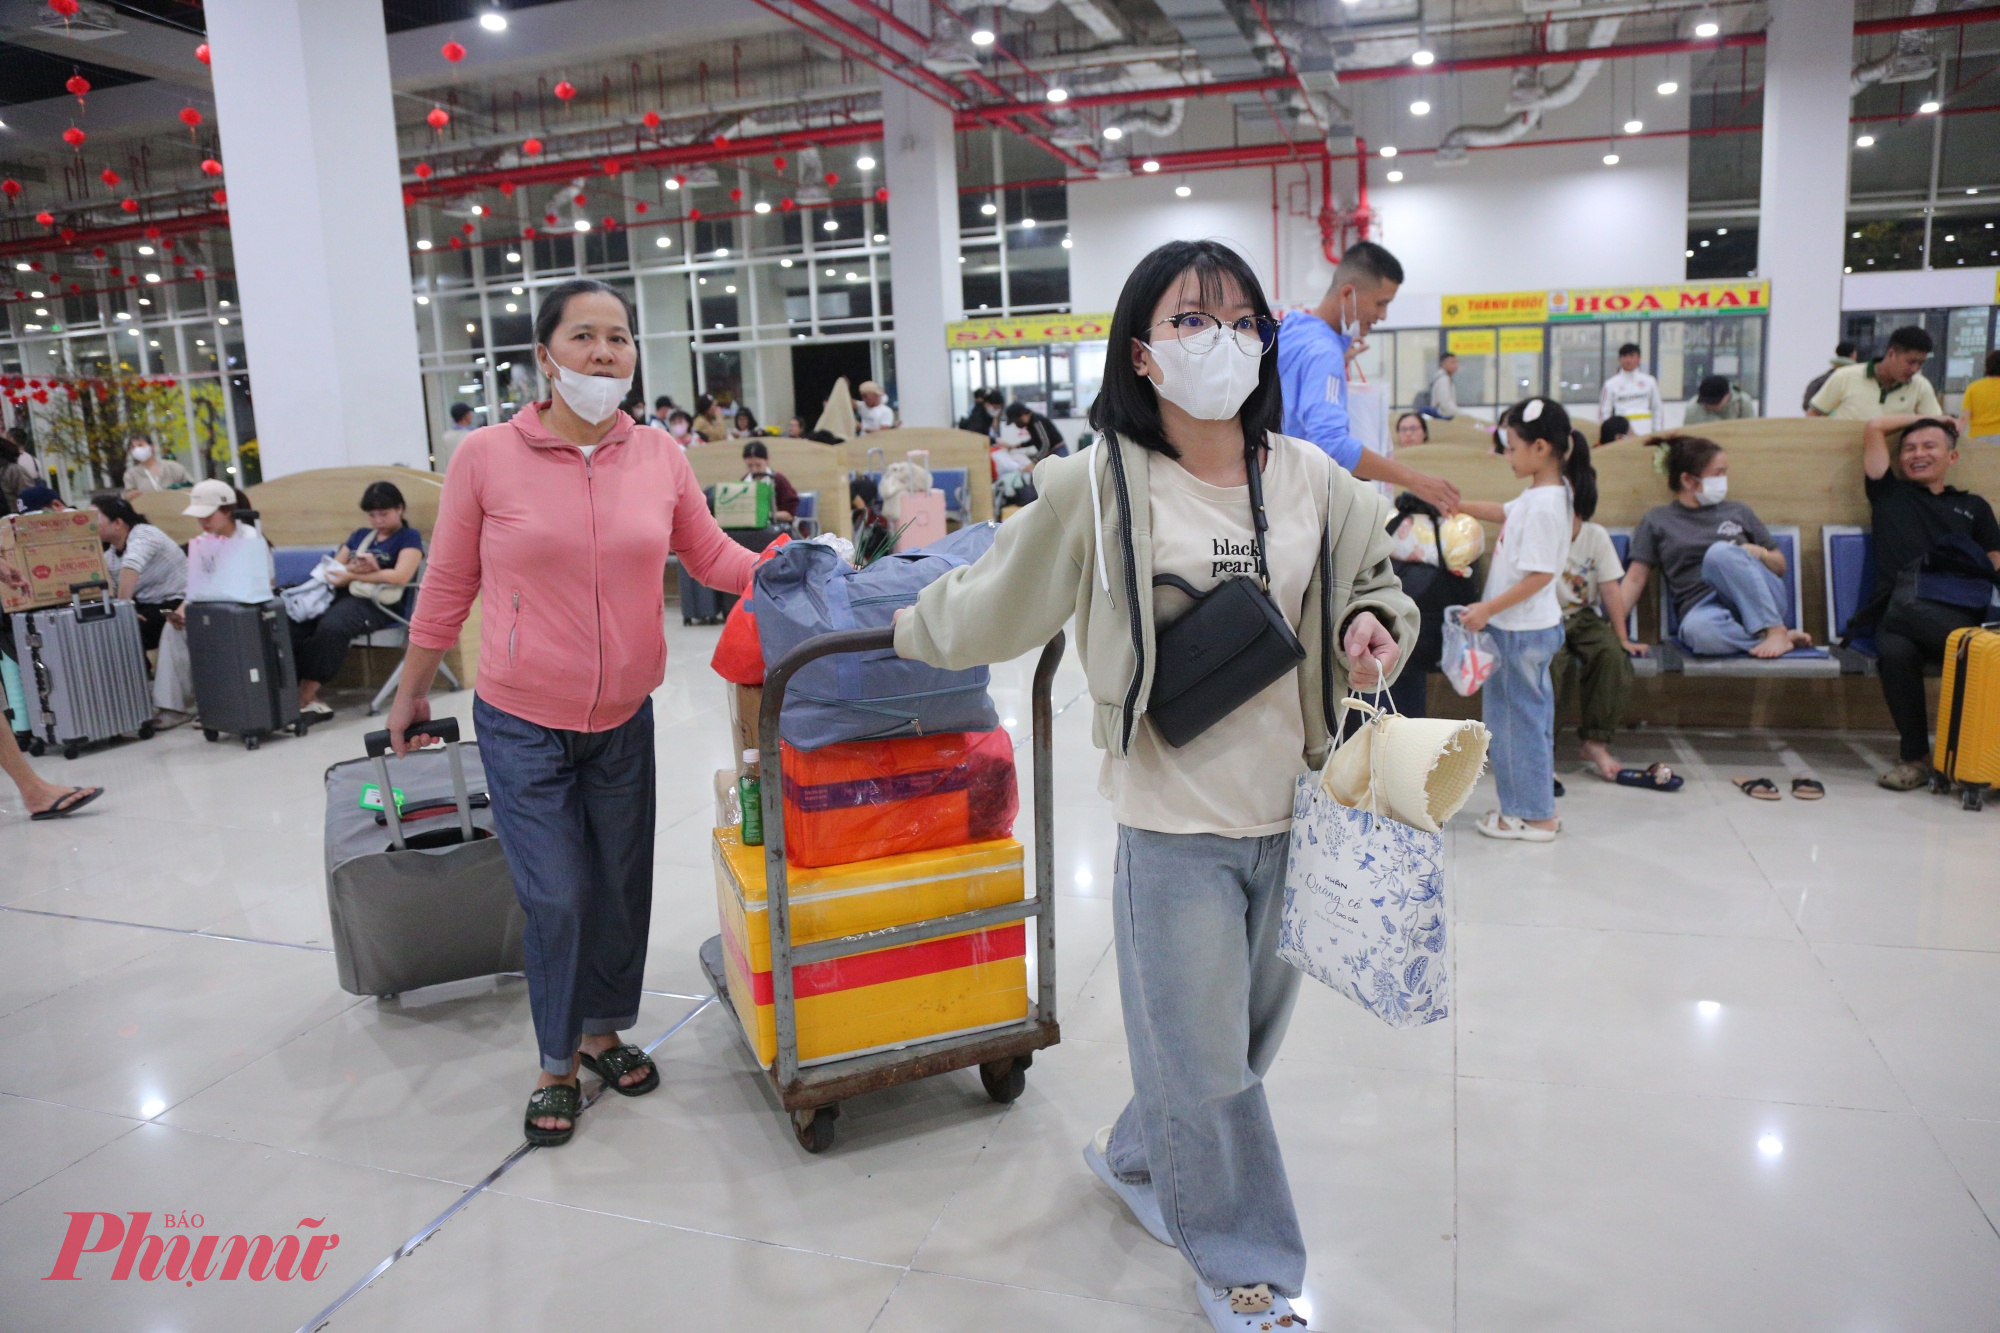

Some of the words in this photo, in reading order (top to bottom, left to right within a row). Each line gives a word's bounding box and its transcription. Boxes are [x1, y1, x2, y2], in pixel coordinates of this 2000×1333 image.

[1574, 293, 1661, 312] HOA
[1680, 290, 1761, 308] MAI
[1044, 322, 1105, 337] GÒ
[1212, 538, 1261, 557] black
